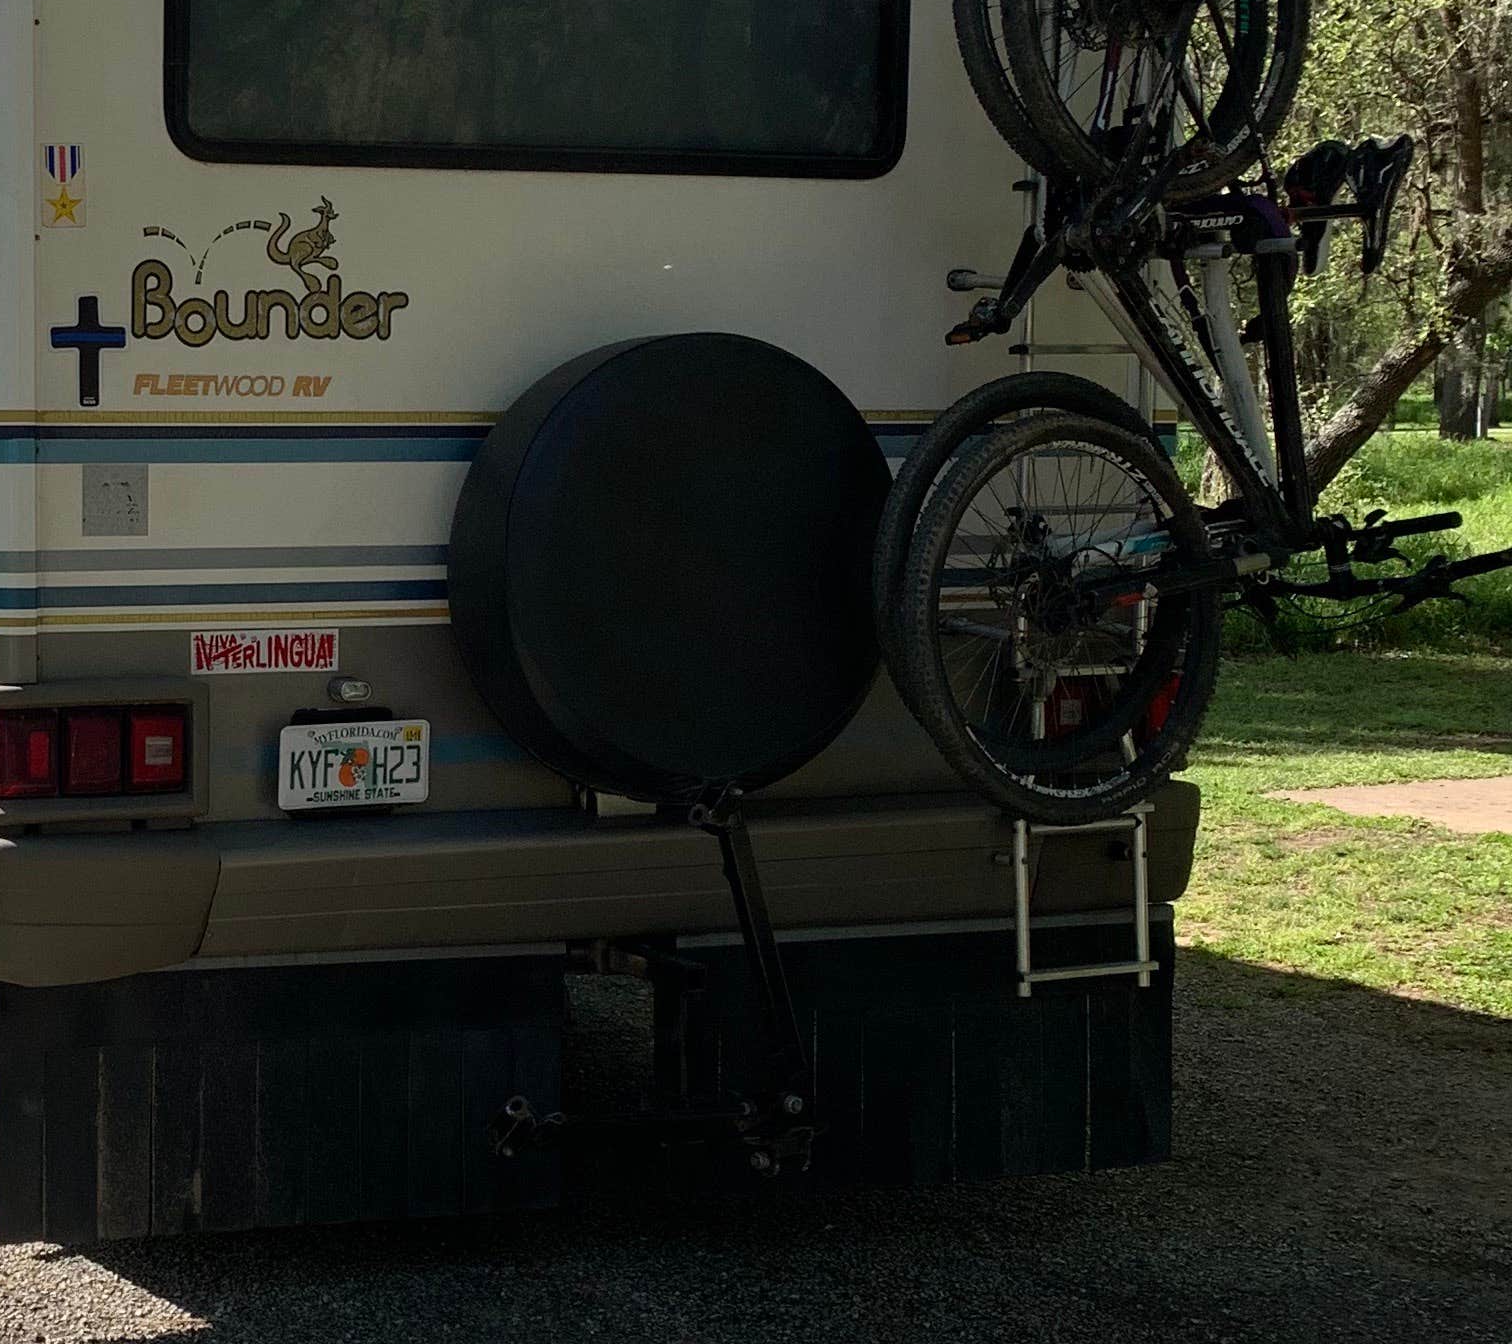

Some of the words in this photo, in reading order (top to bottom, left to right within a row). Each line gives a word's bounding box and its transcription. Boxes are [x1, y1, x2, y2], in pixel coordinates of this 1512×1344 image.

[131, 258, 409, 347] Bounder
[133, 373, 285, 397] FLEETWOOD
[292, 374, 332, 398] RV
[212, 633, 334, 670] TERLINGUA!
[290, 748, 339, 789] KYF
[372, 744, 421, 786] H23
[313, 788, 361, 803] SUNSHINE
[364, 786, 396, 800] STATE
